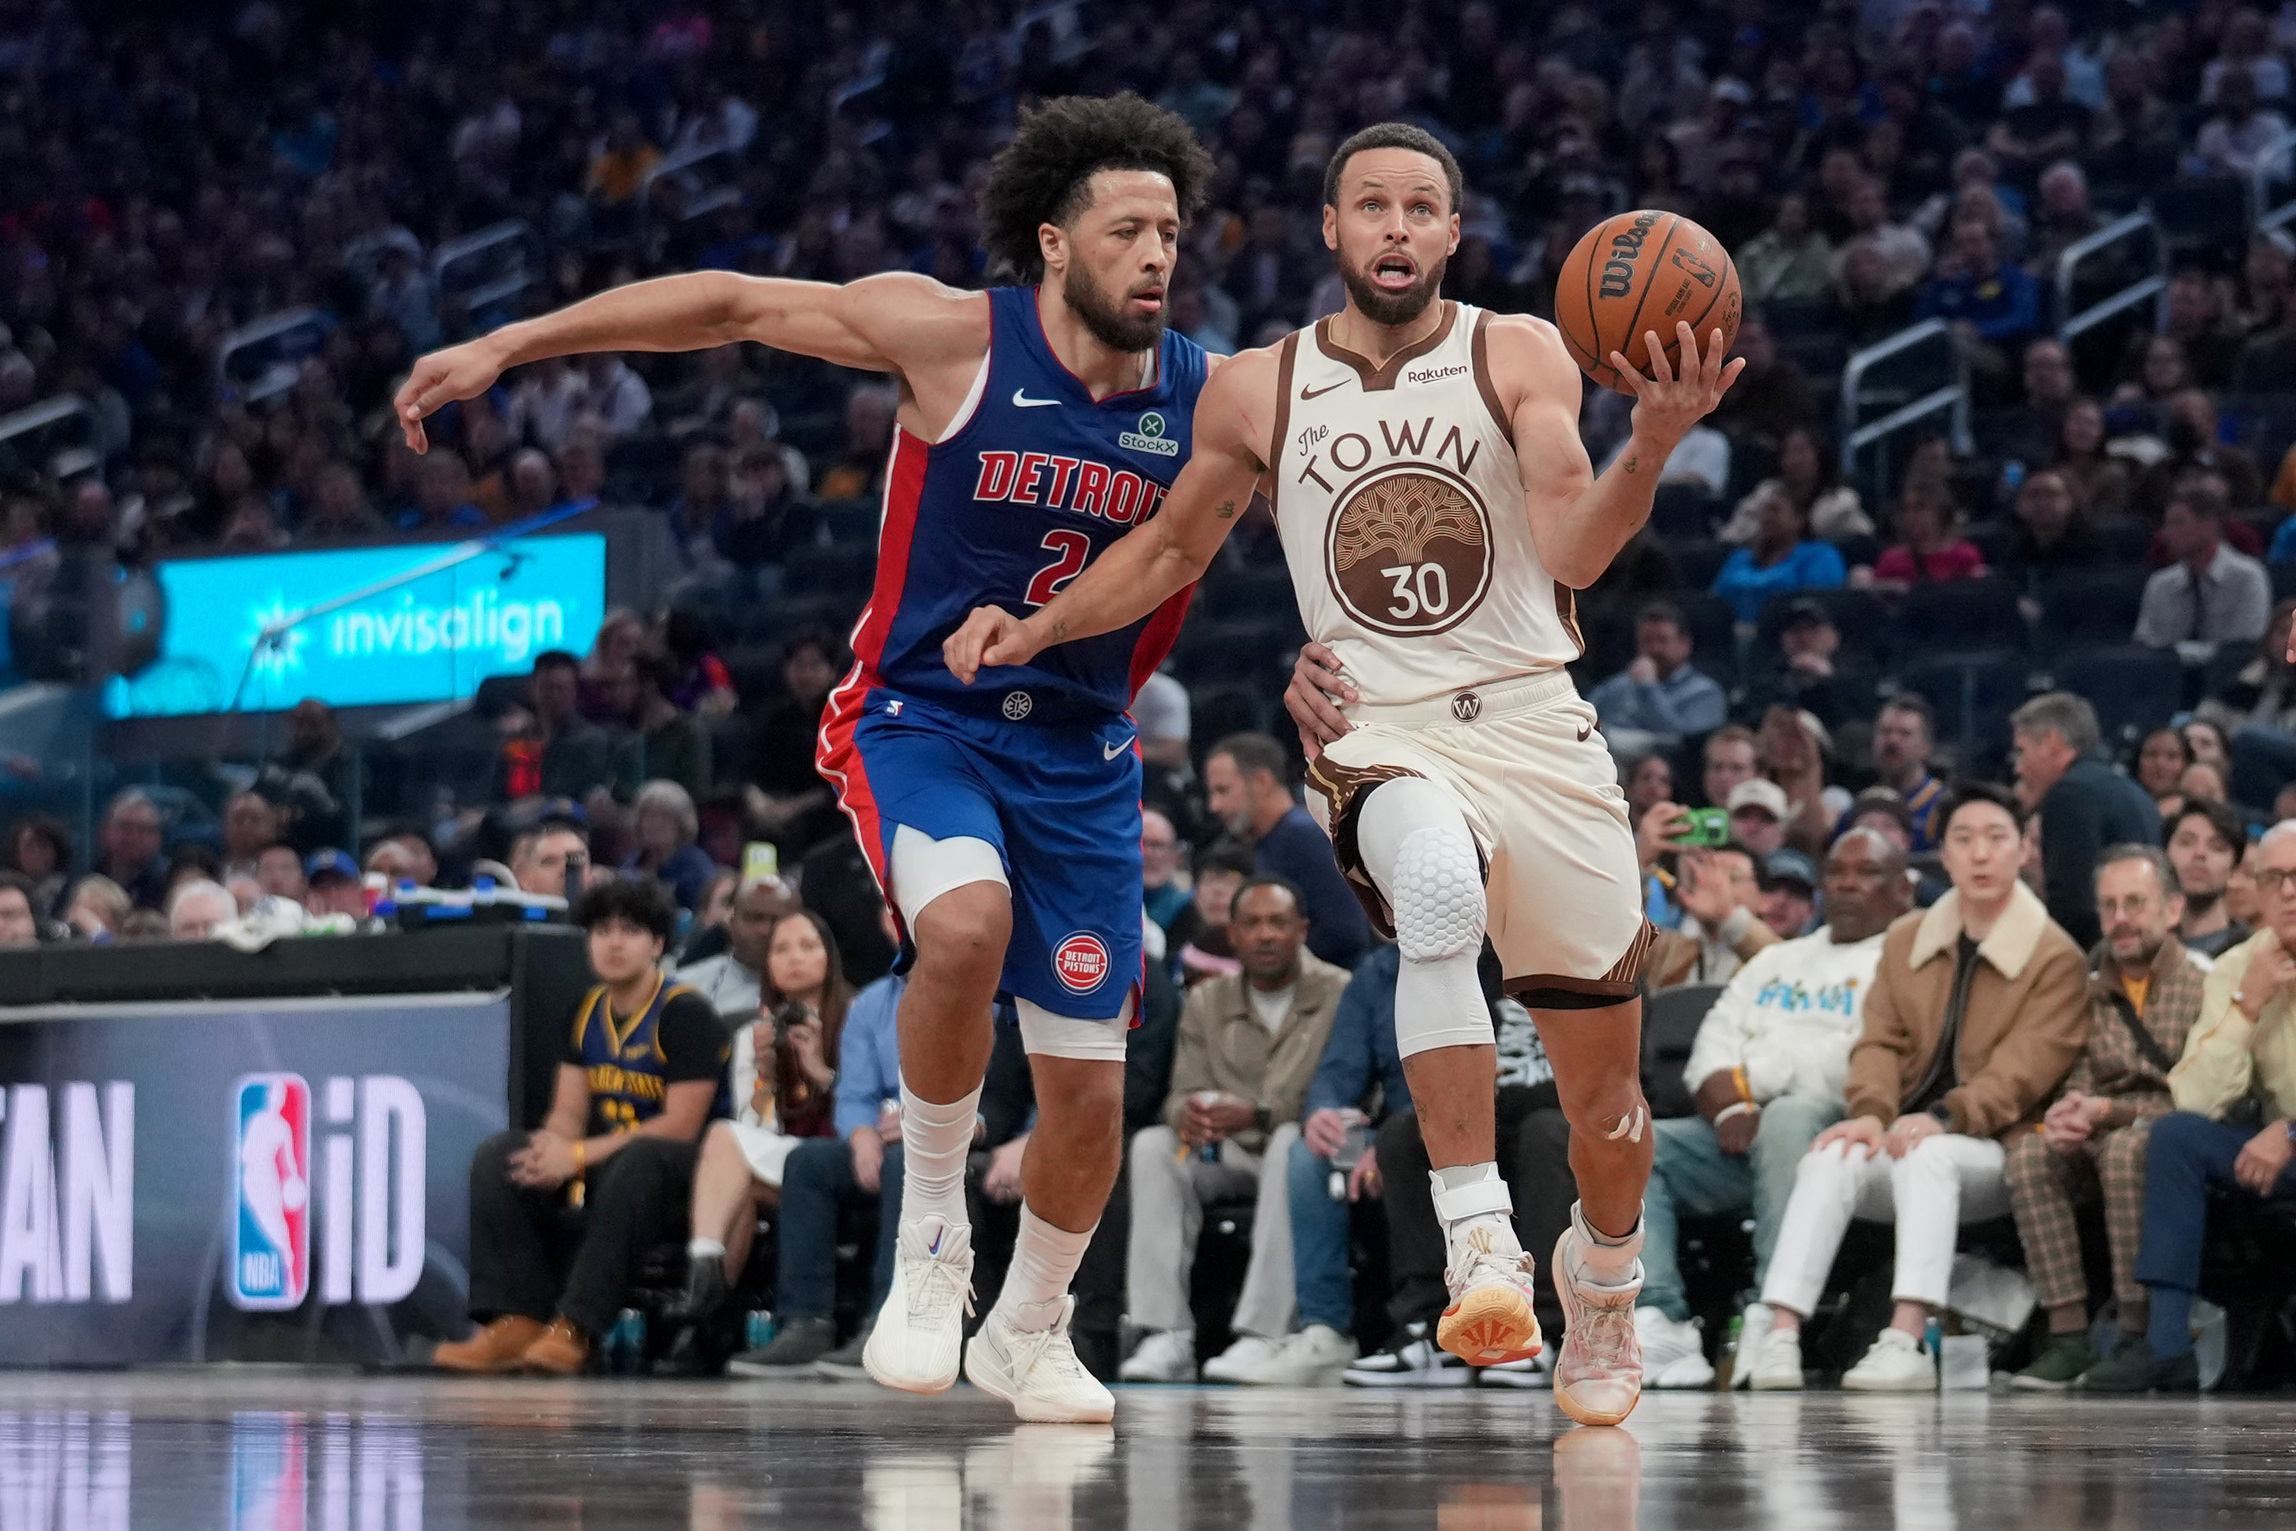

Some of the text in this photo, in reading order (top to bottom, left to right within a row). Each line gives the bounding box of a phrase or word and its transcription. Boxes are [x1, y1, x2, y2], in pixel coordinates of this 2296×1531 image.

[1408, 365, 1467, 383] Rakuten
[1121, 434, 1177, 454] StockX
[1298, 424, 1330, 457] The
[1298, 416, 1481, 496] TOWN
[1023, 528, 1091, 607] 2
[1380, 562, 1449, 619] 30
[334, 585, 563, 663] invisalign
[1063, 960, 1100, 974] PISTONS
[1065, 950, 1101, 964] DETROIT
[0, 1080, 134, 1302] AN
[325, 1076, 427, 1304] iD
[243, 1251, 282, 1290] NBA
